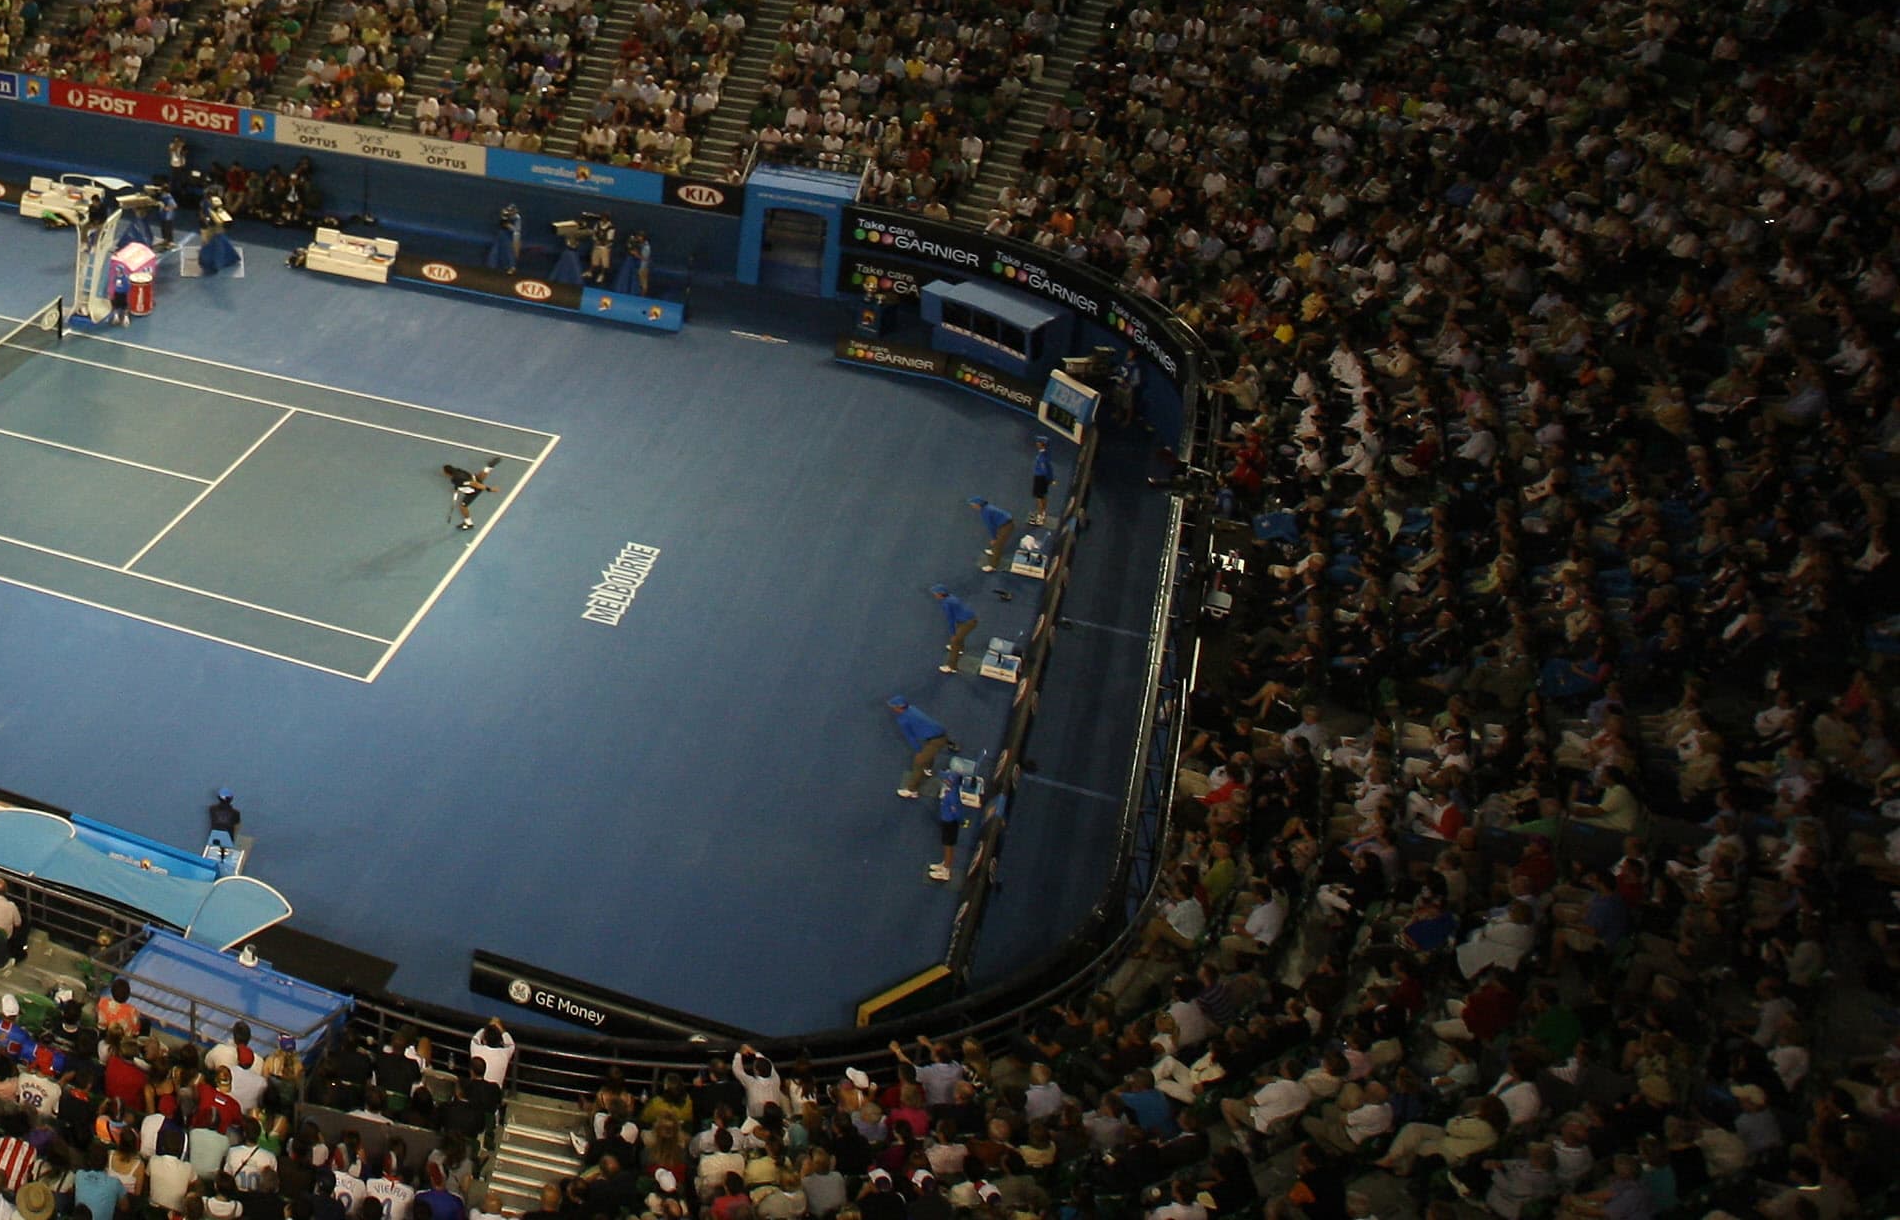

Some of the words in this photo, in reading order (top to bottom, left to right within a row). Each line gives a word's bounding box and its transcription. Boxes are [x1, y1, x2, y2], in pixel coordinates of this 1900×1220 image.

[87, 94, 137, 115] POST
[182, 108, 234, 130] POST
[299, 135, 338, 149] OPTUS
[362, 144, 402, 159] OPTUS
[427, 155, 467, 170] OPTUS
[684, 187, 717, 204] KIA
[857, 218, 885, 232] Take
[888, 224, 918, 238] care.
[894, 235, 980, 268] GARNIER
[996, 250, 1022, 268] Take
[426, 265, 452, 280] KIA
[856, 263, 884, 276] Take
[519, 282, 547, 297] KIA
[1028, 273, 1099, 316] GARNIER
[1110, 301, 1130, 324] Take
[875, 351, 934, 372] GARNIER
[1133, 329, 1176, 379] GARNIER
[980, 379, 1033, 406] GARNIER
[586, 544, 656, 623] MELBOURNE
[535, 991, 555, 1008] GE
[557, 997, 606, 1026] Money
[22, 1091, 43, 1107] 98
